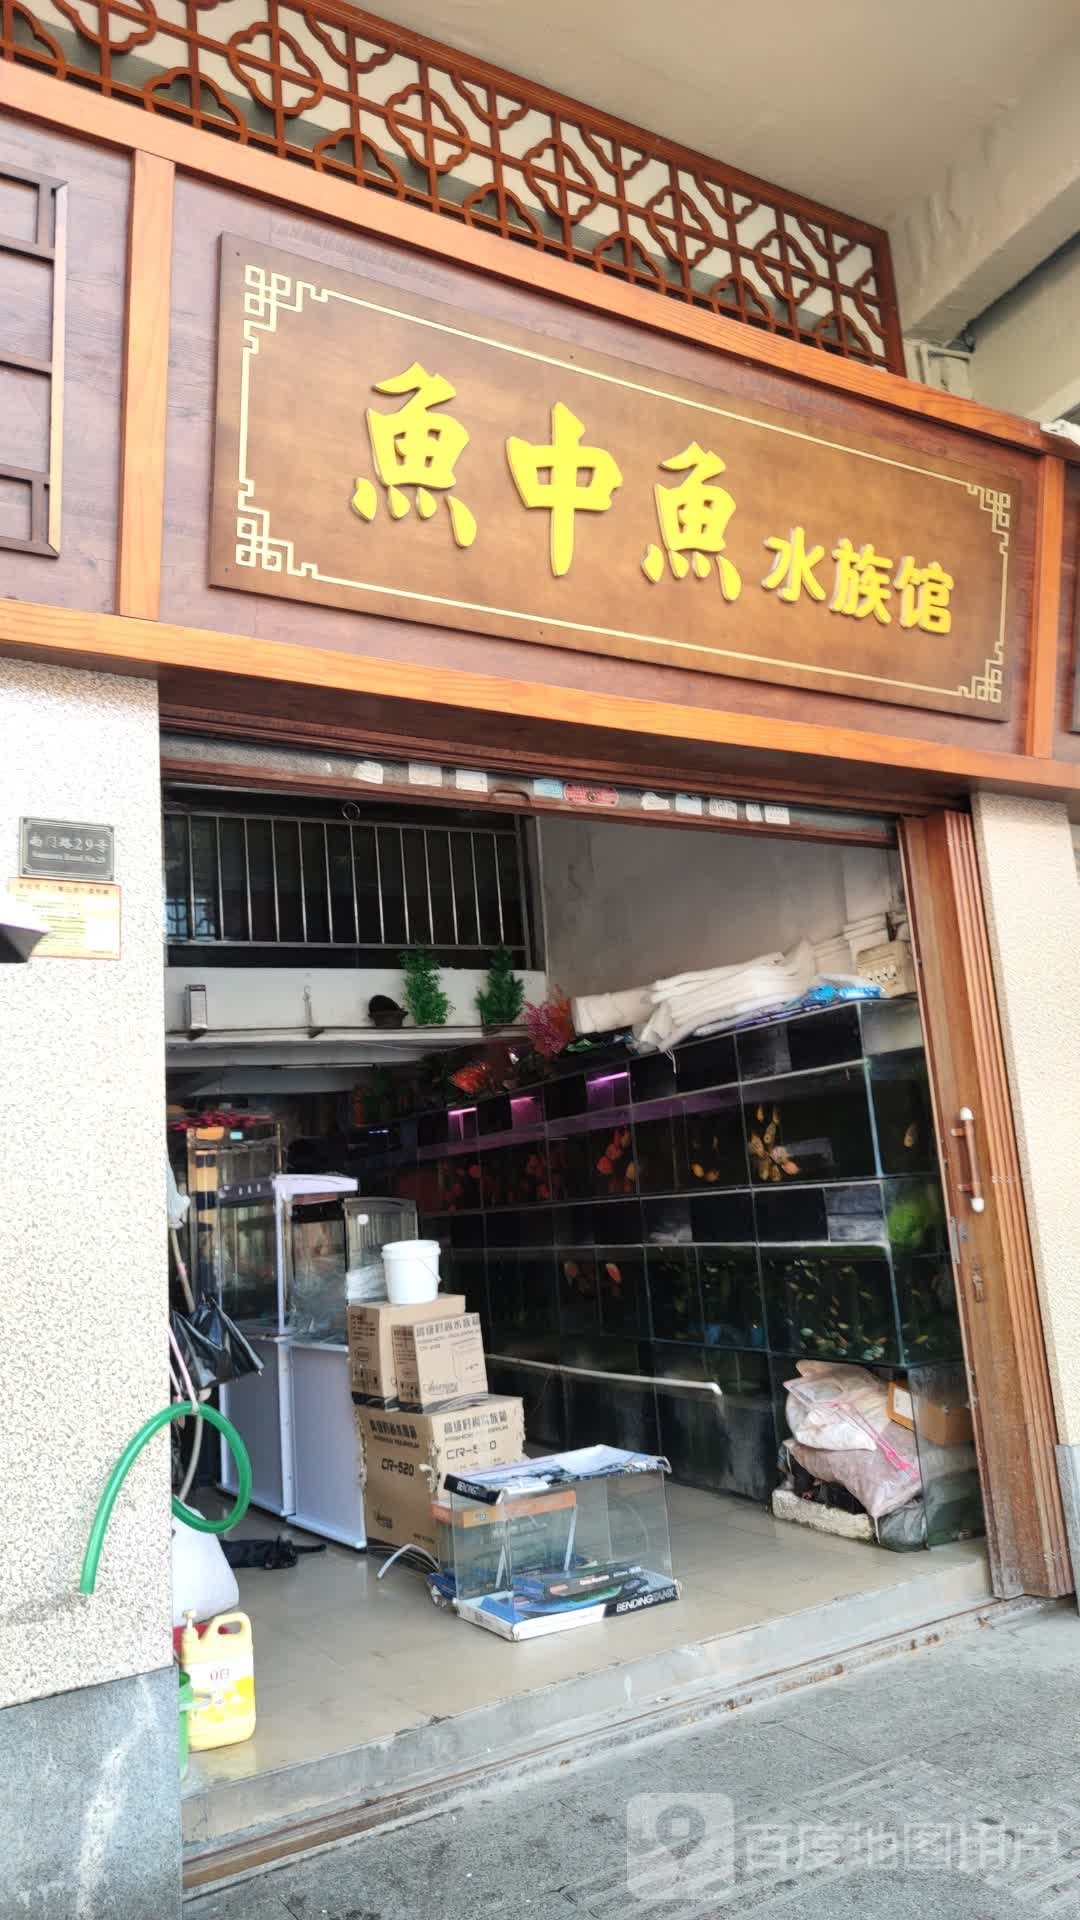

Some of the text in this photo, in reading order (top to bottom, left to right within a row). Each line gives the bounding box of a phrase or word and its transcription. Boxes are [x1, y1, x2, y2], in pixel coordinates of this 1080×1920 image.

[351, 361, 955, 635] 魚中魚 水族馆
[446, 1440, 497, 1460] CR-50
[380, 1457, 415, 1477] CR-520
